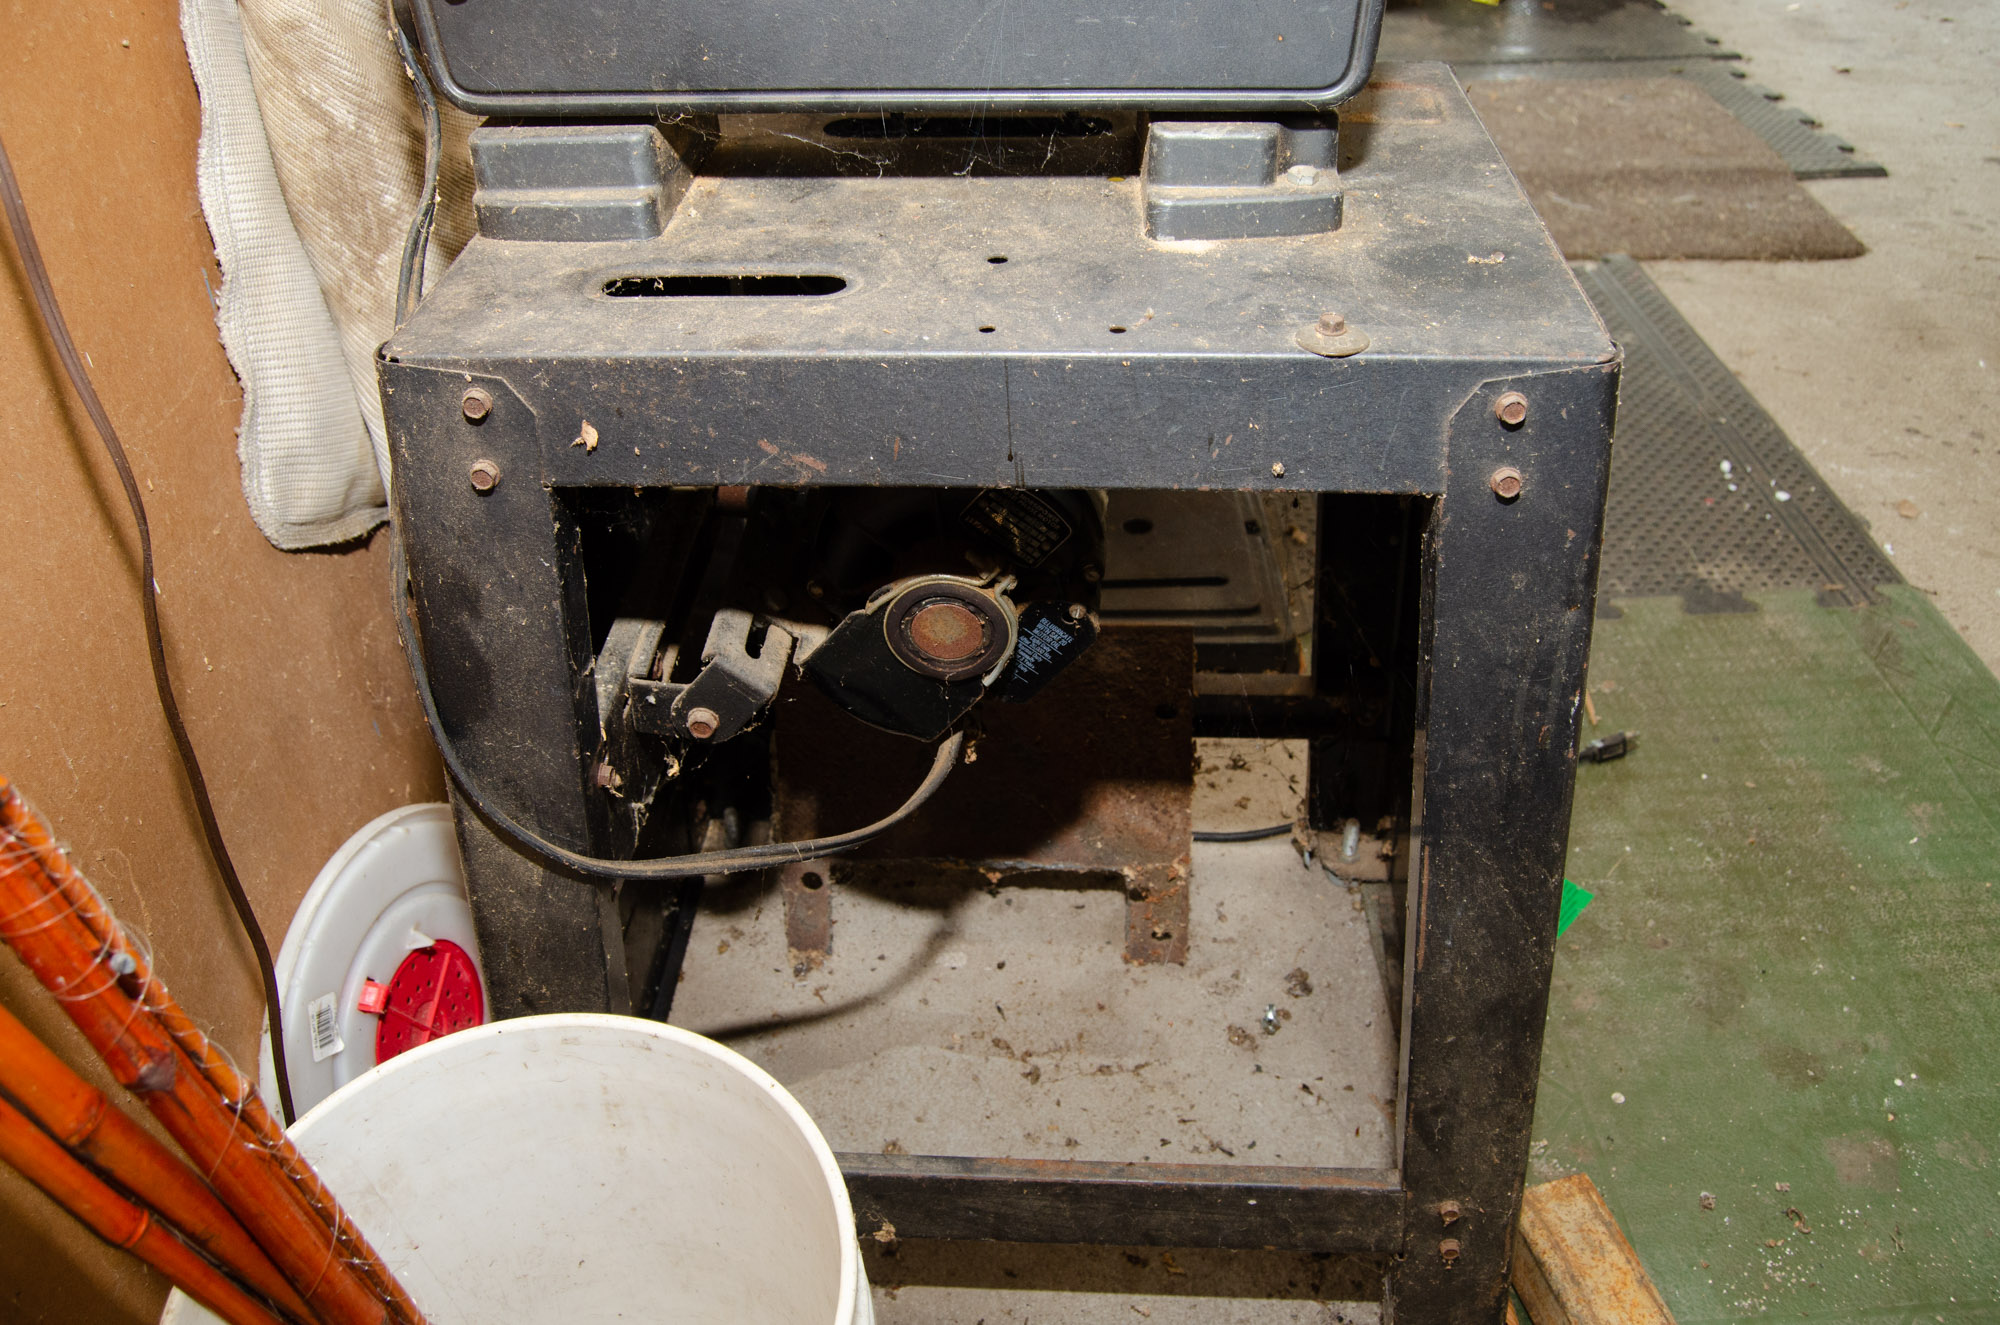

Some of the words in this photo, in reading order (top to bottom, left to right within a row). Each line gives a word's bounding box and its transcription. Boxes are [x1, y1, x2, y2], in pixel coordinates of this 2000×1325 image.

[1032, 627, 1052, 643] MOTOR
[1050, 640, 1060, 649] OIL
[1036, 622, 1051, 634] WITH
[1049, 631, 1061, 641] SAE
[1039, 617, 1074, 643] RELUBRICATE
